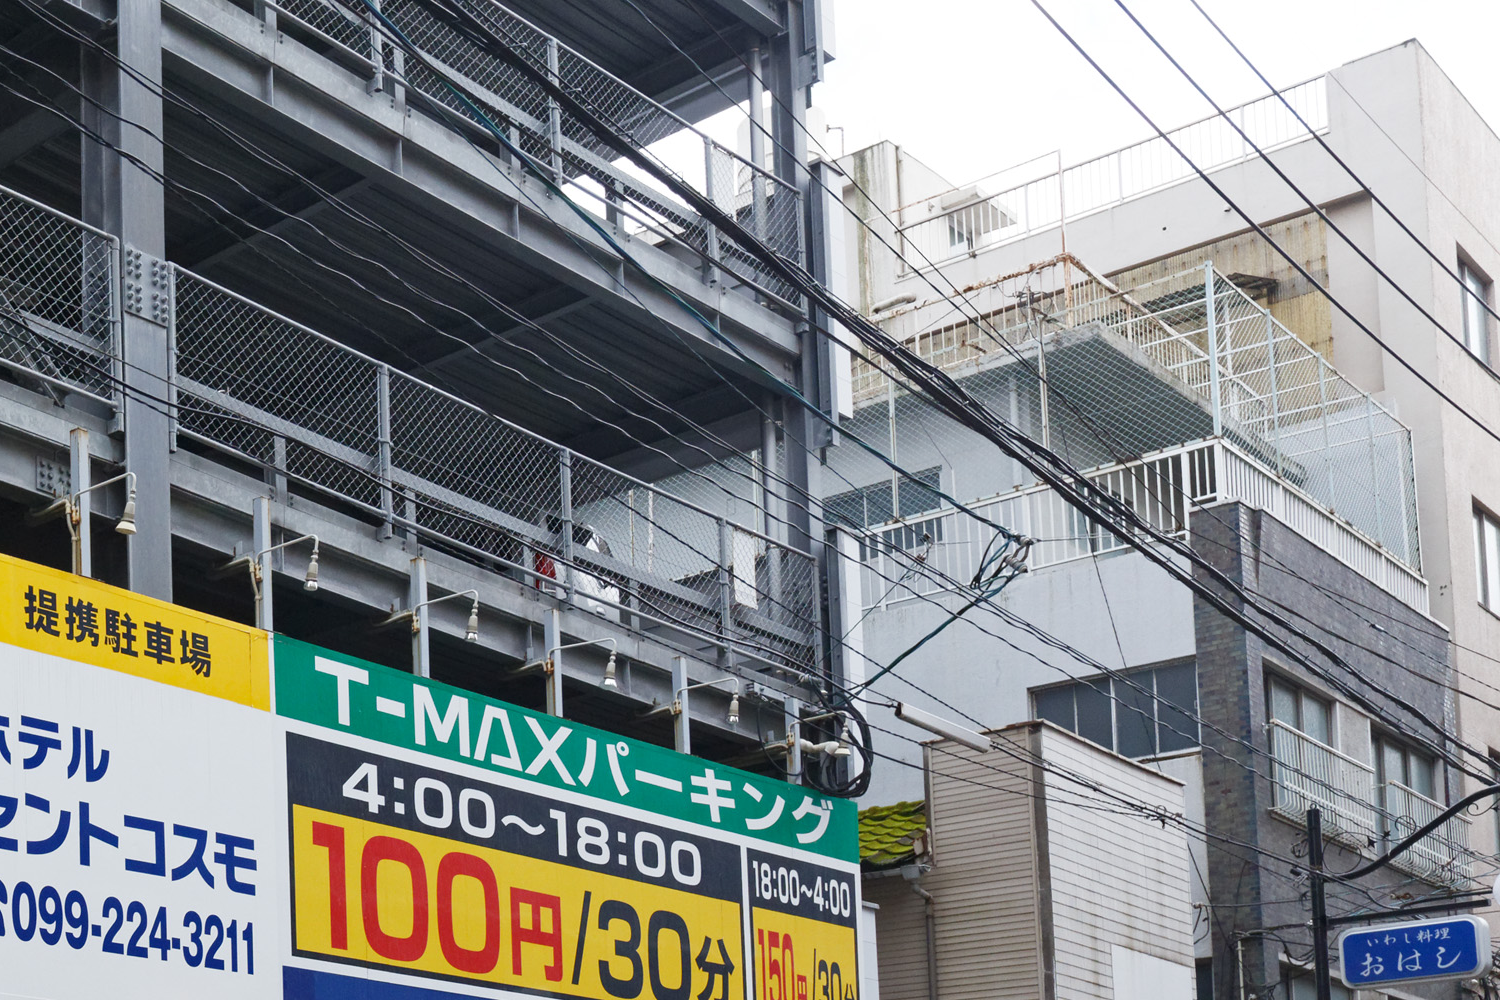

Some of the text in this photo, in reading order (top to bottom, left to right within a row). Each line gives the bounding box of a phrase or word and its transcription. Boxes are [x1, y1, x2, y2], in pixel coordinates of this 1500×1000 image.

[24, 585, 212, 678] 提携駐車場
[314, 655, 834, 844] T-MAXパーキング
[11, 880, 255, 976] 099-224-3211
[1366, 926, 1452, 947] いわし料理
